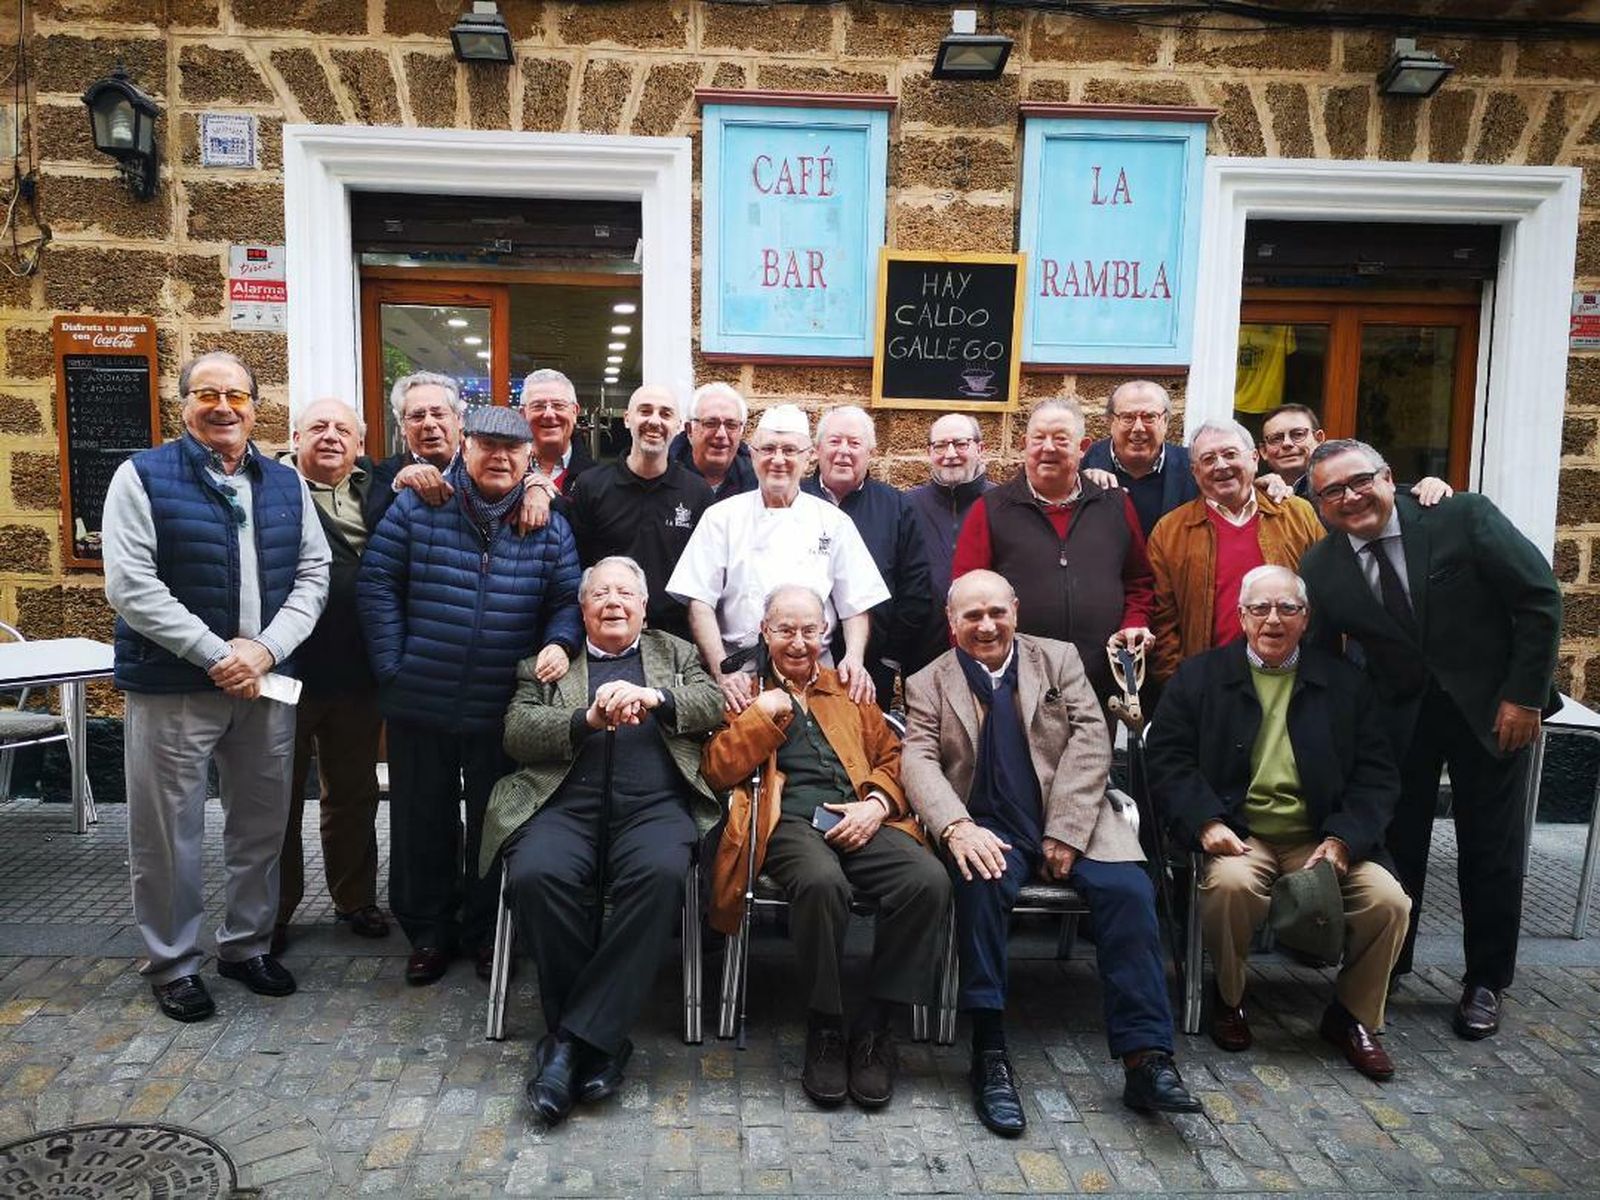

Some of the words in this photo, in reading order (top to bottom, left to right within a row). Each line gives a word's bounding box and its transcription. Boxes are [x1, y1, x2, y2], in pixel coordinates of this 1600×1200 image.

[752, 145, 834, 196] CAFÉ
[1091, 166, 1133, 205] LA
[761, 249, 827, 288] BAR
[1040, 258, 1172, 299] RAMBLA
[232, 281, 285, 294] Alarma
[922, 272, 971, 299] HAY
[61, 322, 103, 332] Disfruta
[105, 324, 116, 332] tu
[119, 324, 147, 333] menú
[895, 302, 989, 328] CALDO
[888, 335, 1004, 361] GALLEGO
